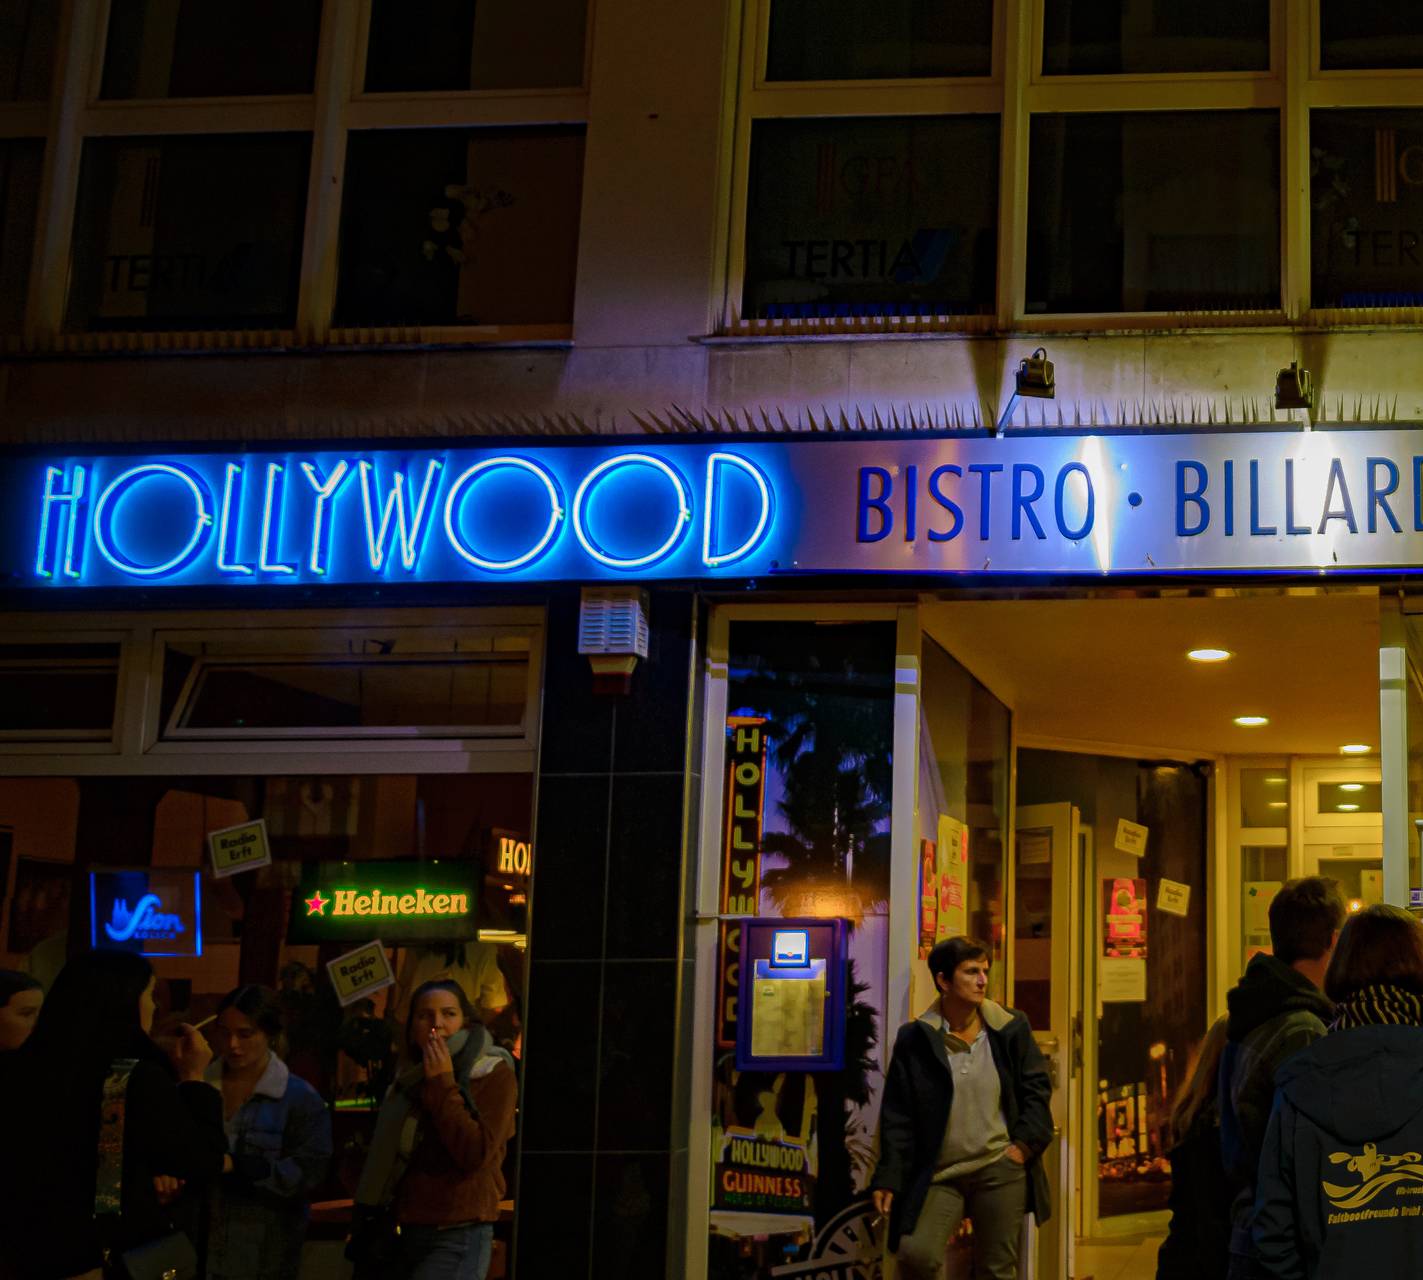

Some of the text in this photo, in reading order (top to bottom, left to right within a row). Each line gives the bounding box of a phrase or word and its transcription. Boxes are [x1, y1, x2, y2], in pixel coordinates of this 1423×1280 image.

[105, 254, 240, 292] TERTIA
[782, 239, 922, 279] TERTIA
[35, 451, 772, 579] HOLLYWOOD
[857, 461, 1096, 544] BISTRO
[220, 833, 257, 849] Radio
[332, 889, 468, 916] Heineken
[340, 954, 376, 977] Radio
[731, 1138, 805, 1172] HOLLYWOOD
[722, 1169, 801, 1198] GUINNESS
